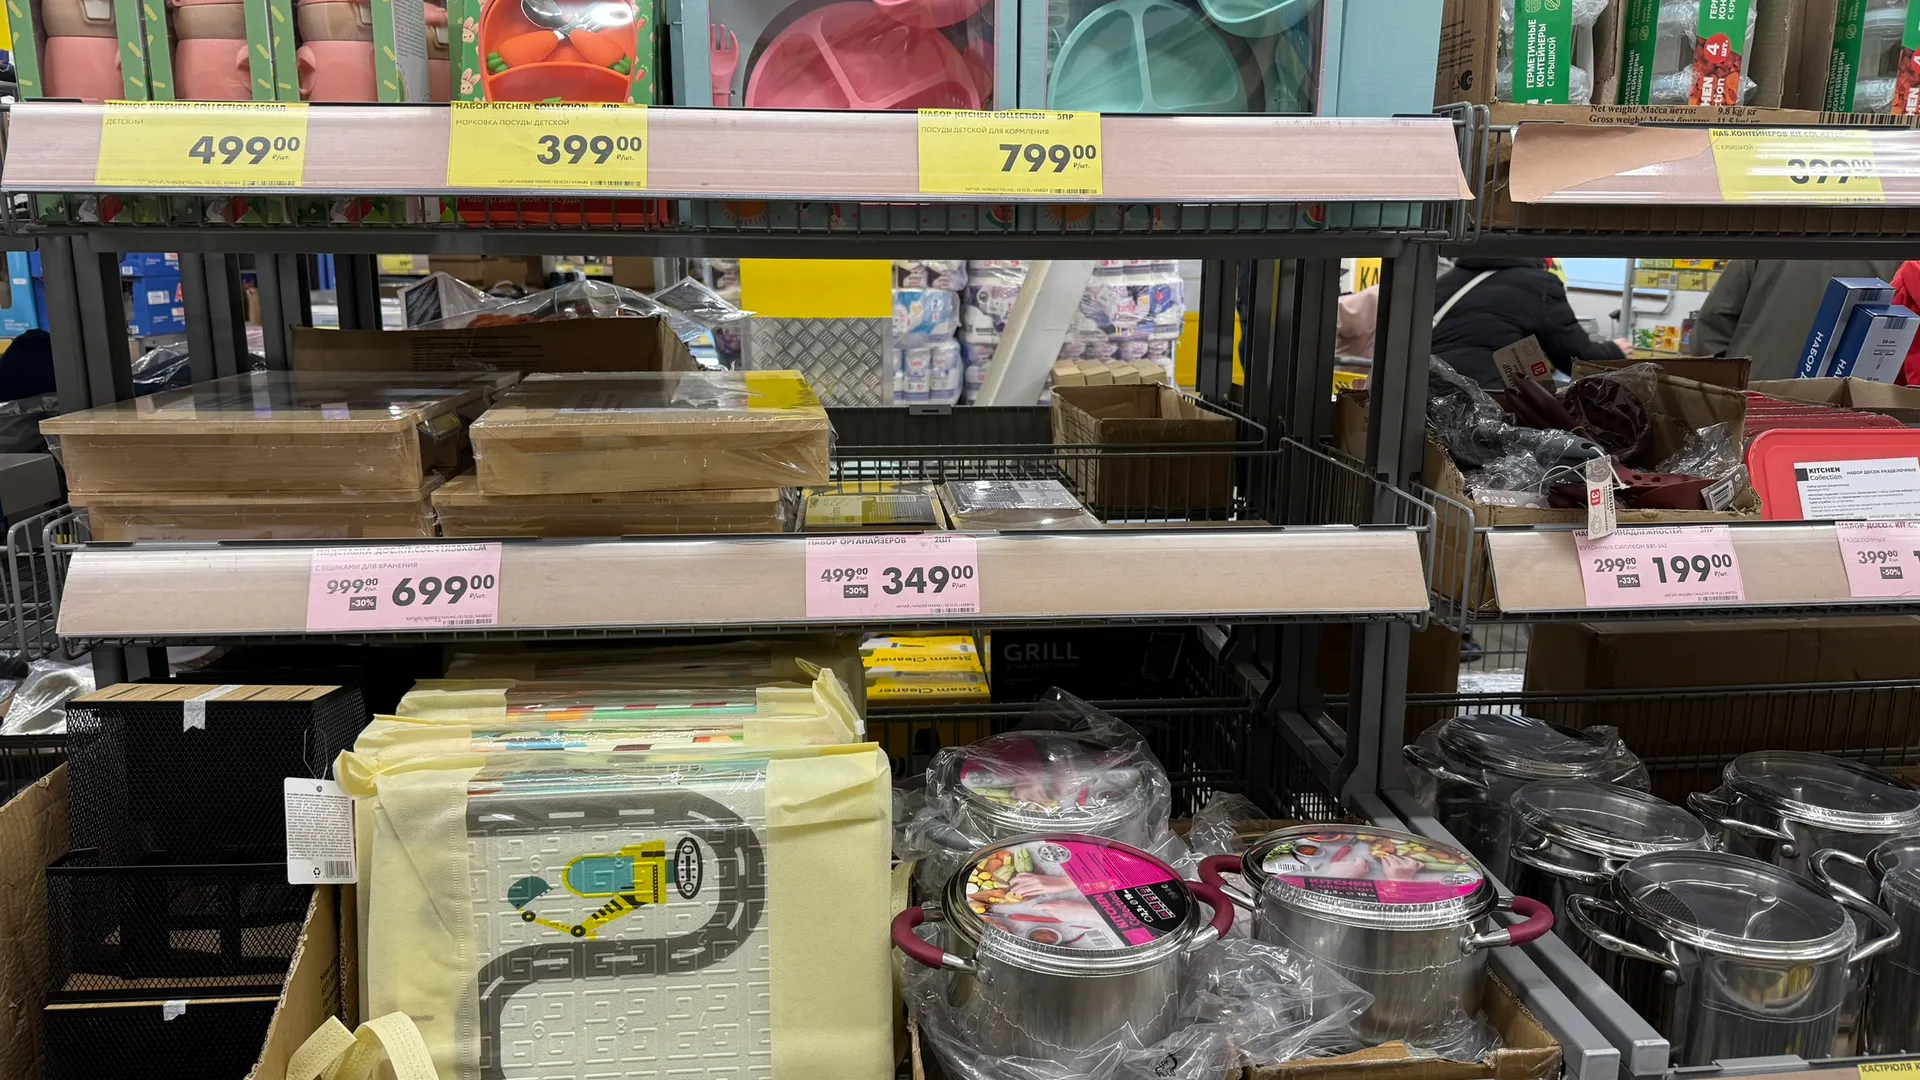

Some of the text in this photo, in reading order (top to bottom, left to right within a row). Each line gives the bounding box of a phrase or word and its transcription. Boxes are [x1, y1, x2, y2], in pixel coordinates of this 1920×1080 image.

[1526, 19, 1537, 88] ГЕРМЕТИЧНЫЕ
[1536, 23, 1547, 88] КОНТЕЙНЕРЫ
[1706, 43, 1719, 56] 4
[1721, 40, 1729, 57] шт.
[1548, 36, 1556, 87] С КРЫШКОЙ
[1629, 53, 1640, 105] ОНТЕЙНЕРЫ
[1700, 77, 1714, 106] HEN
[1906, 88, 1920, 115] HEN
[1589, 115, 1614, 123] Gross
[1717, 107, 1731, 116] 9.8
[954, 127, 988, 135] ДЕТСКОЙ
[1805, 331, 1824, 372] НАБОР
[1833, 358, 1847, 379] НА
[1882, 568, 1900, 576] -50%
[845, 587, 867, 595] -30%
[351, 599, 375, 607] -30%
[1004, 642, 1080, 661] GRILL
[938, 686, 982, 694] Steam
[1310, 878, 1373, 888] KITCHEN
[1311, 883, 1375, 893] Collection
[1094, 894, 1128, 929] KITCHEN
[1109, 891, 1141, 927] Collection
[1861, 1063, 1912, 1072] КАСТРЮЛЯ
